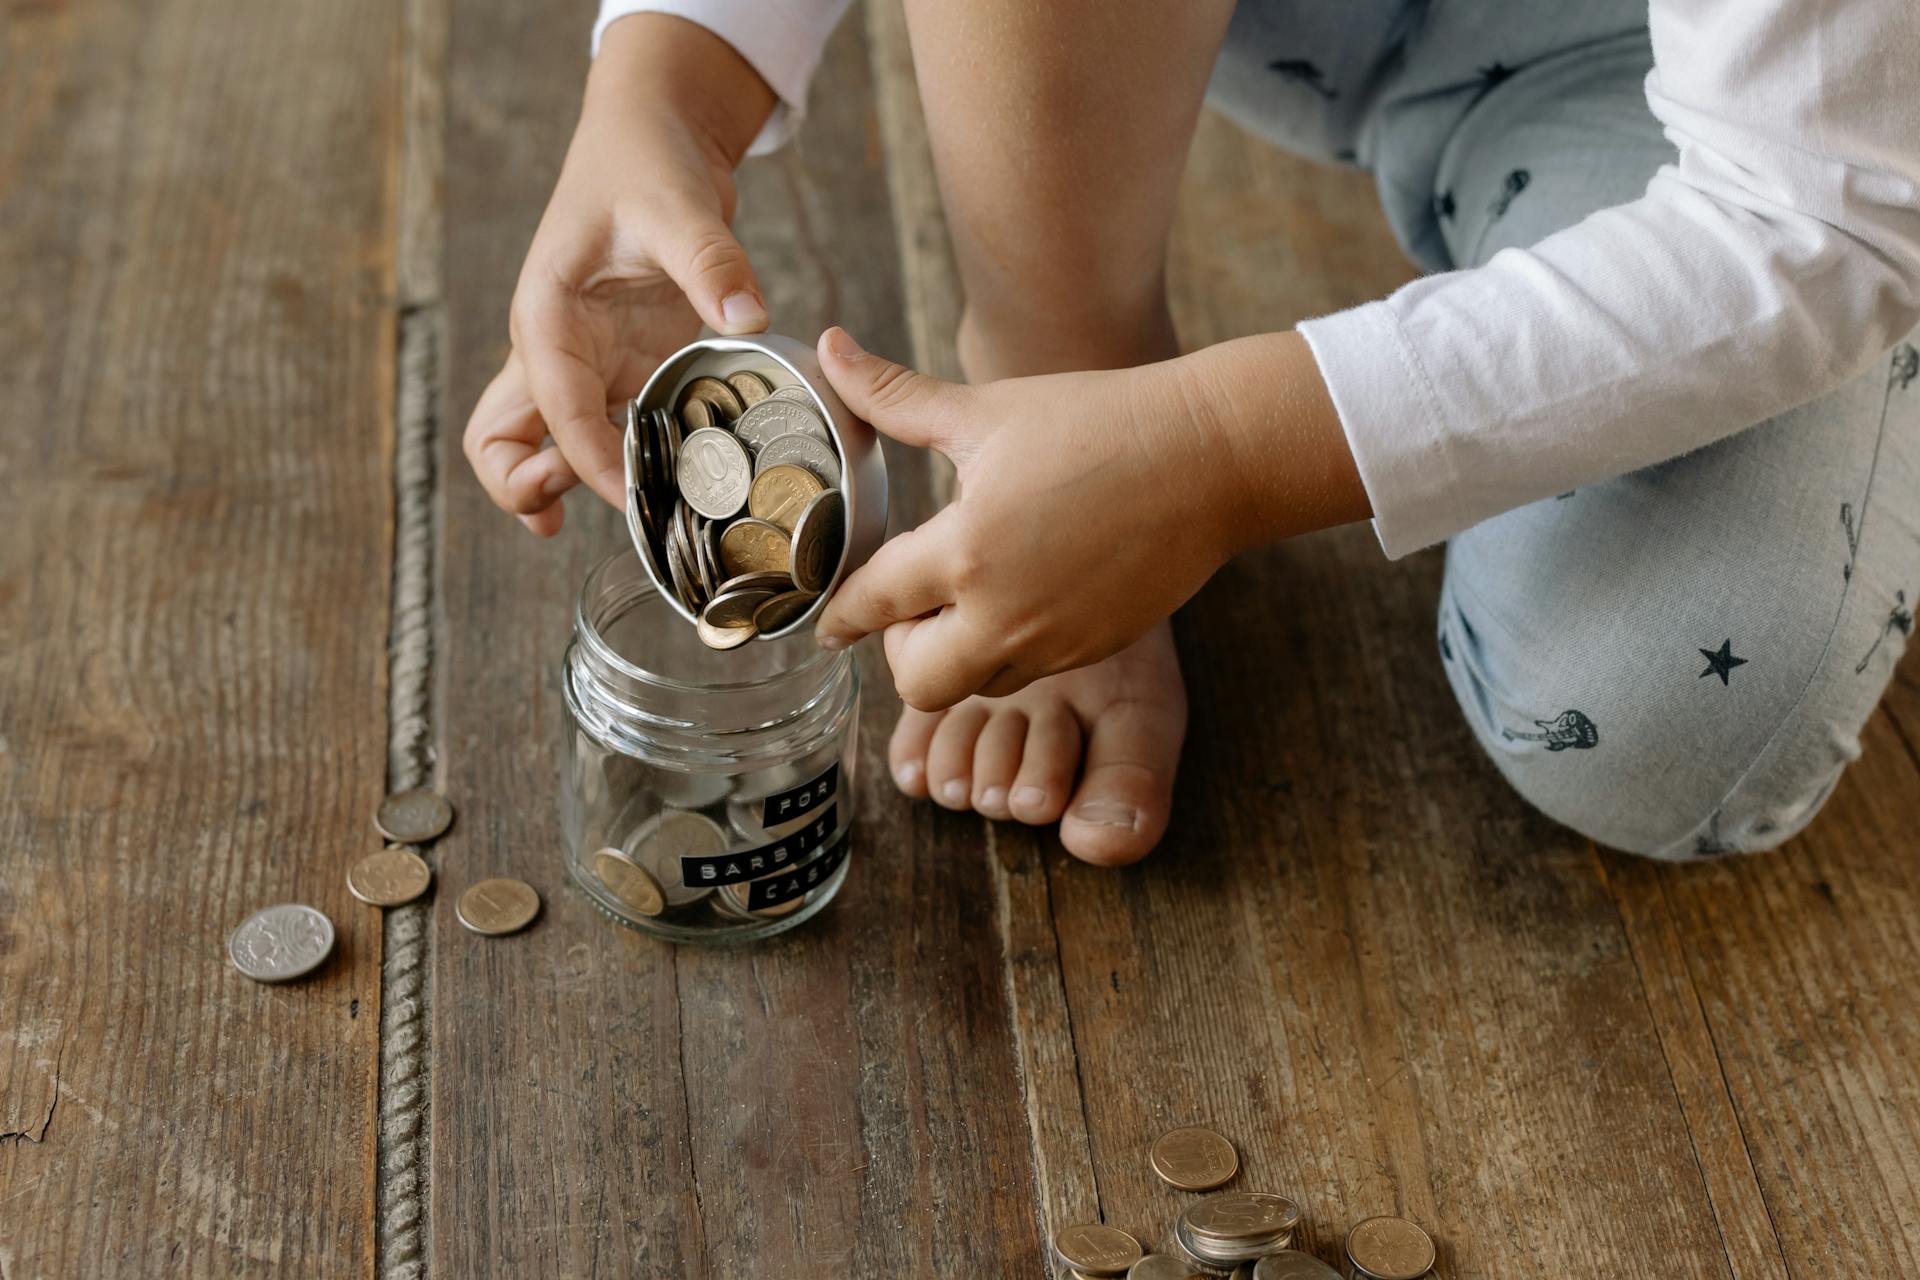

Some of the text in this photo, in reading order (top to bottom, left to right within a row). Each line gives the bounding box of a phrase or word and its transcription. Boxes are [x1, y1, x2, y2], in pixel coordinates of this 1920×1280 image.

[686, 439, 728, 490] 10
[780, 781, 827, 815] FOR
[700, 821, 825, 880] BARBIE
[765, 849, 842, 899] CAST
